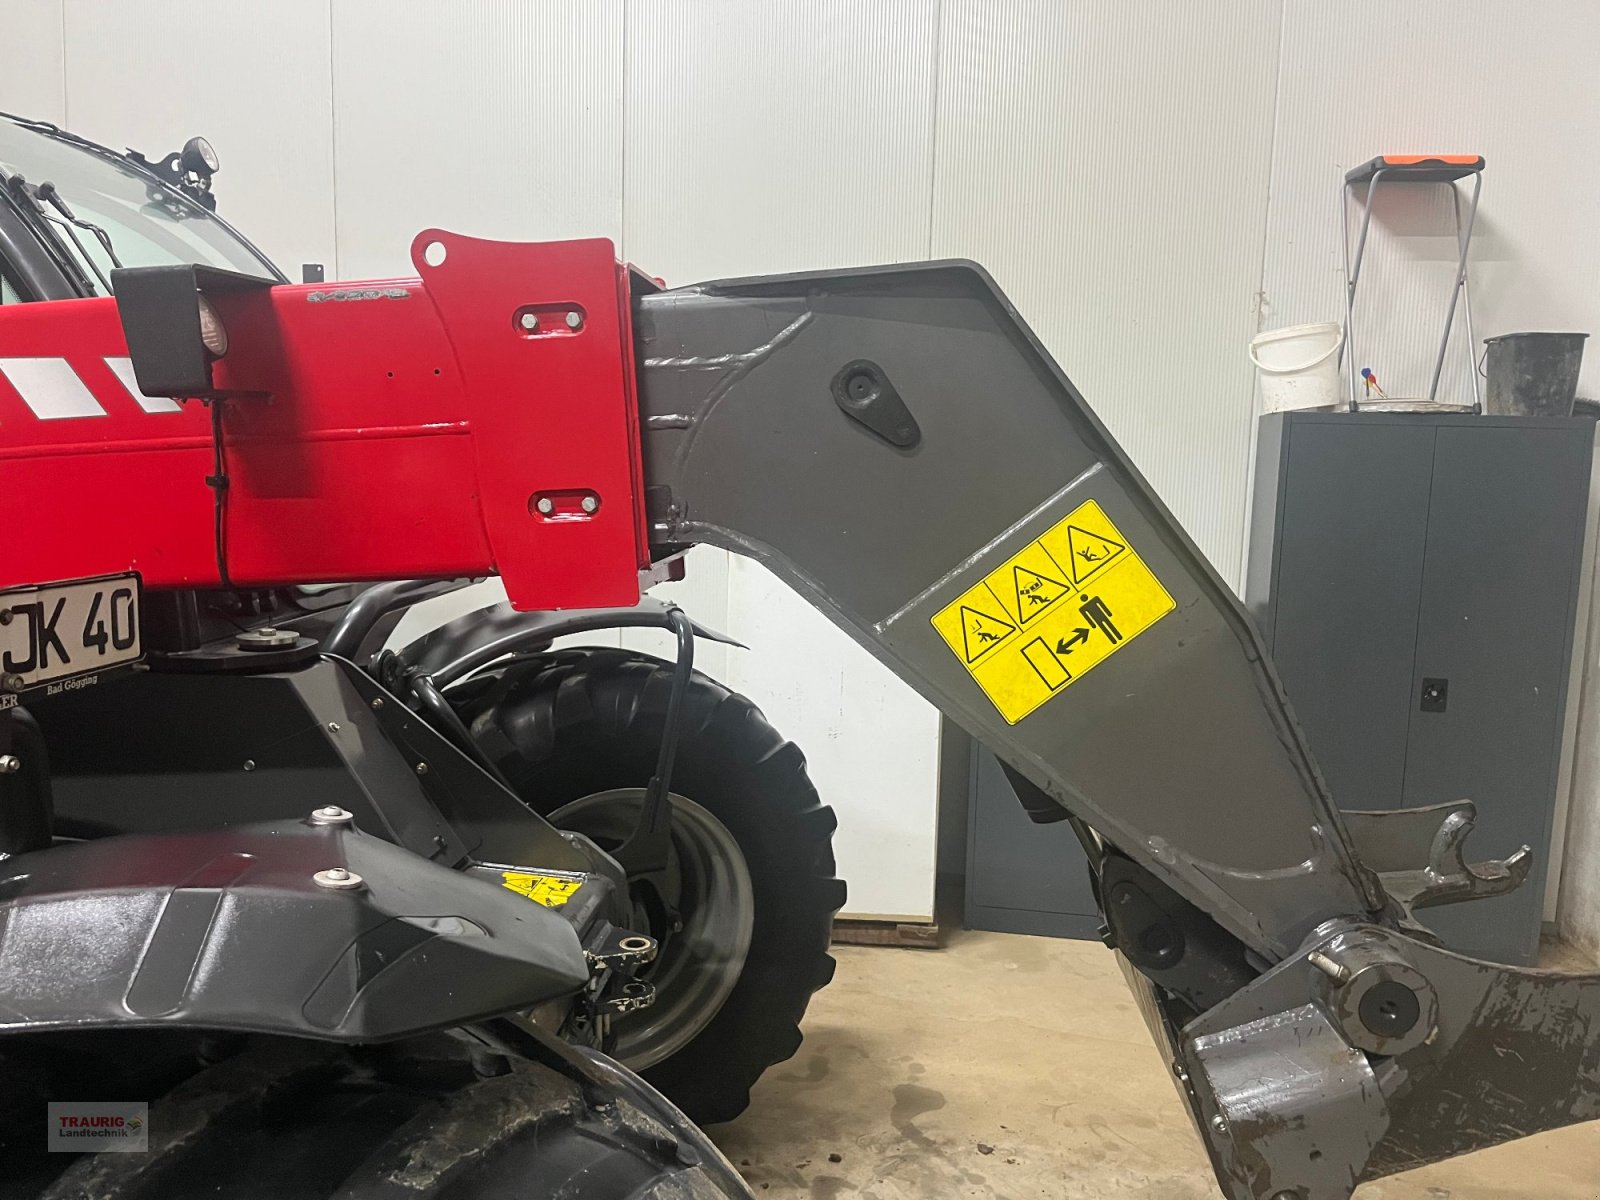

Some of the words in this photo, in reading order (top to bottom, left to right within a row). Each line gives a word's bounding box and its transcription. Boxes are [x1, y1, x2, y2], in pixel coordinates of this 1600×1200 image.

[3, 597, 71, 674] JK
[83, 588, 135, 655] 40
[47, 682, 63, 695] Bad
[64, 675, 98, 690] Gögging
